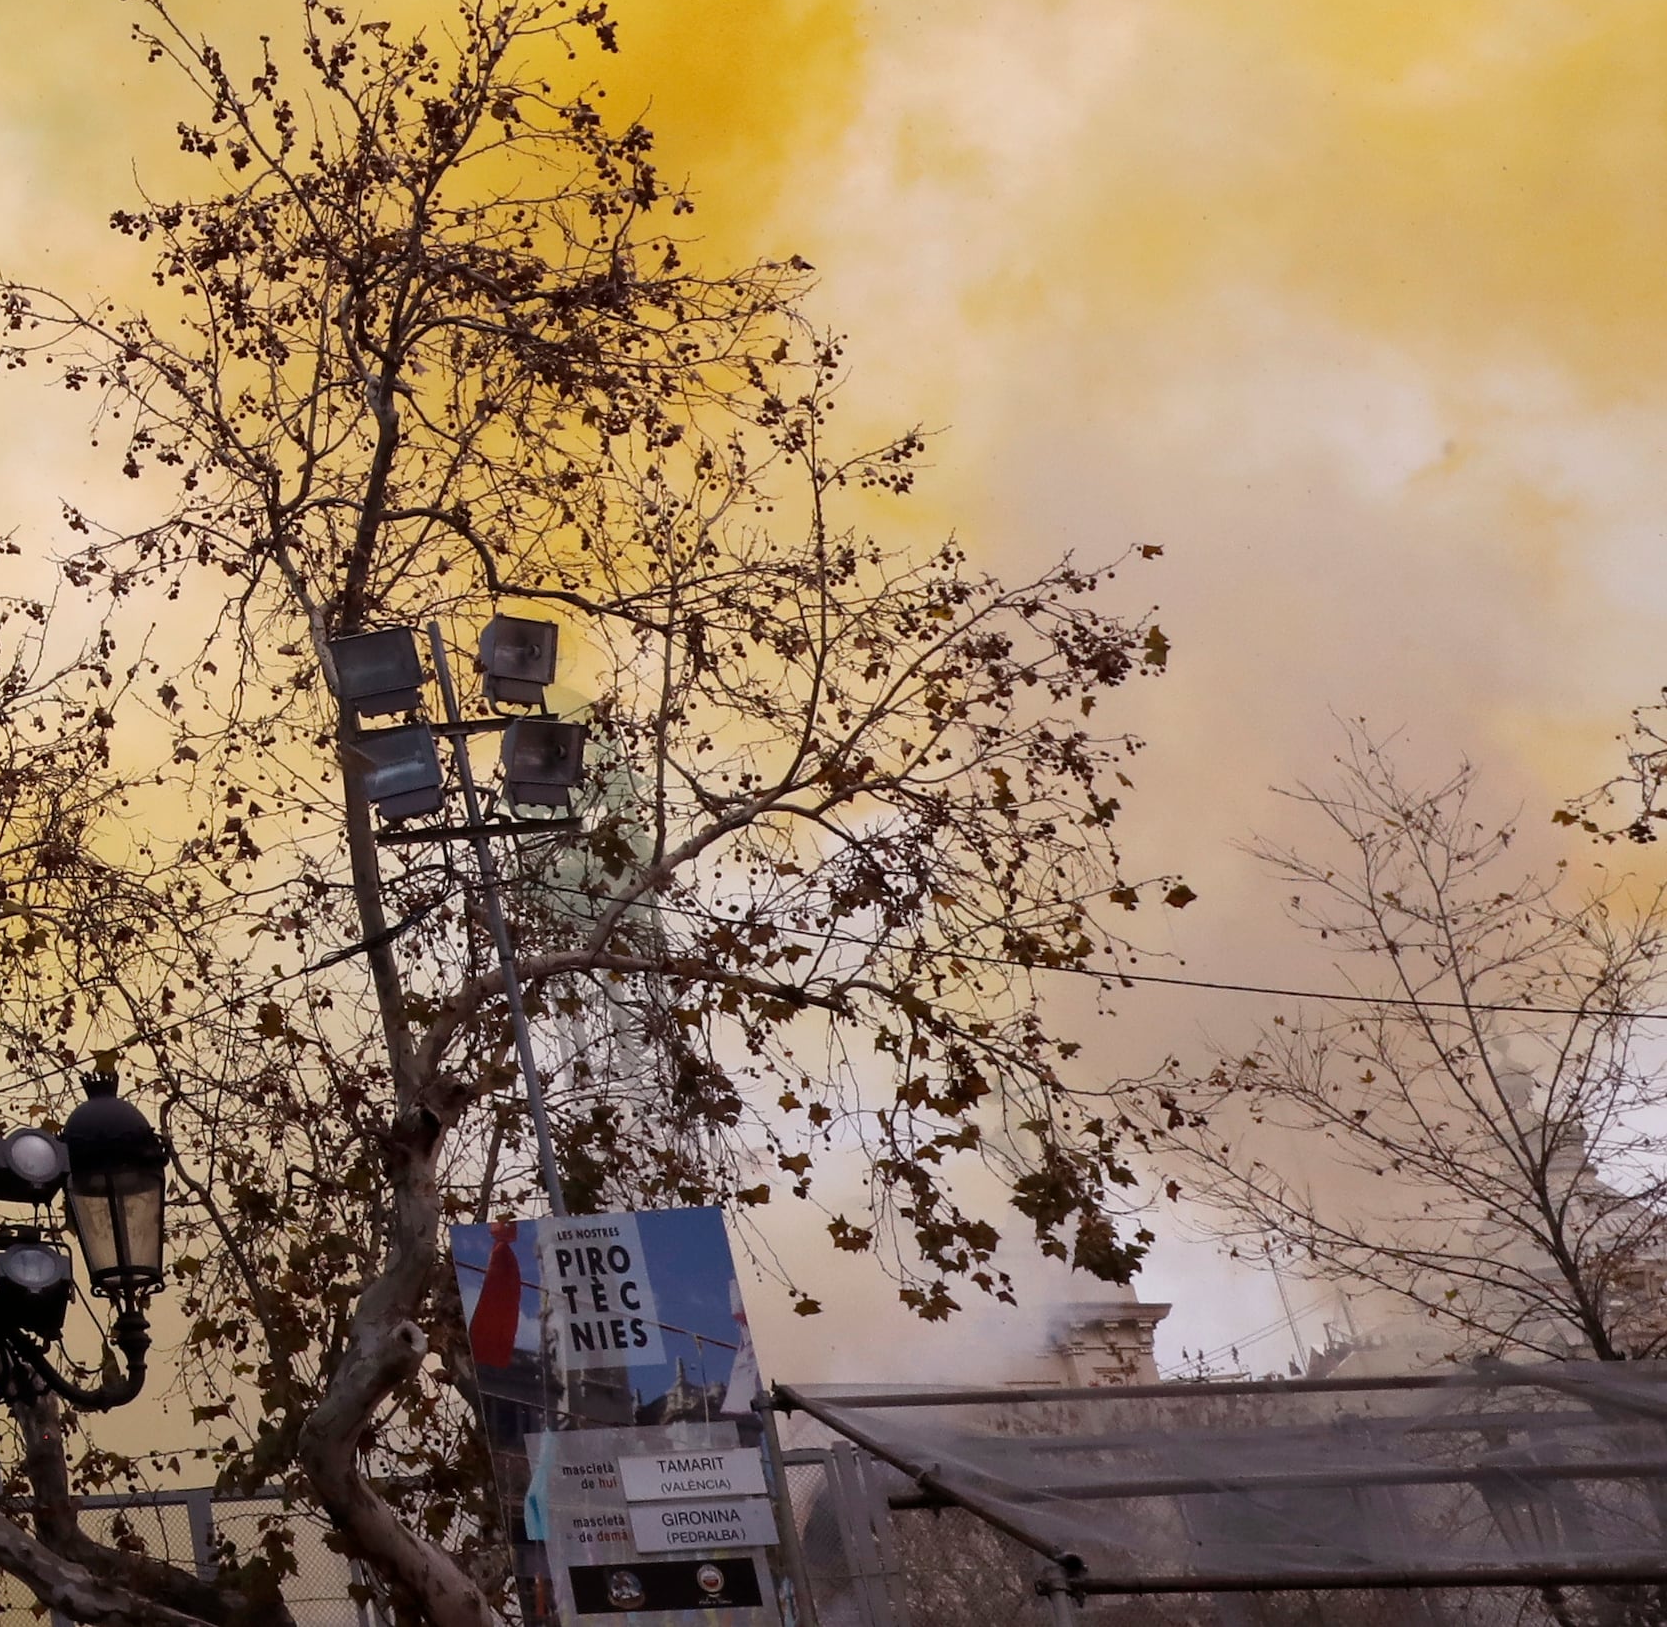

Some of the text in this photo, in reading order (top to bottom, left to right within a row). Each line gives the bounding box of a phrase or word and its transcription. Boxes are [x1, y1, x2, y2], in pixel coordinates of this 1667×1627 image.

[557, 1227, 620, 1241] LES NOSTRES
[555, 1245, 631, 1277] PIRO
[570, 1318, 648, 1352] NIES
[657, 1457, 724, 1473] TAMARIT
[581, 1476, 618, 1490] de hui
[661, 1478, 731, 1494] (VALÈNCIA)
[661, 1509, 741, 1527] GIRONINA
[579, 1530, 593, 1542] de
